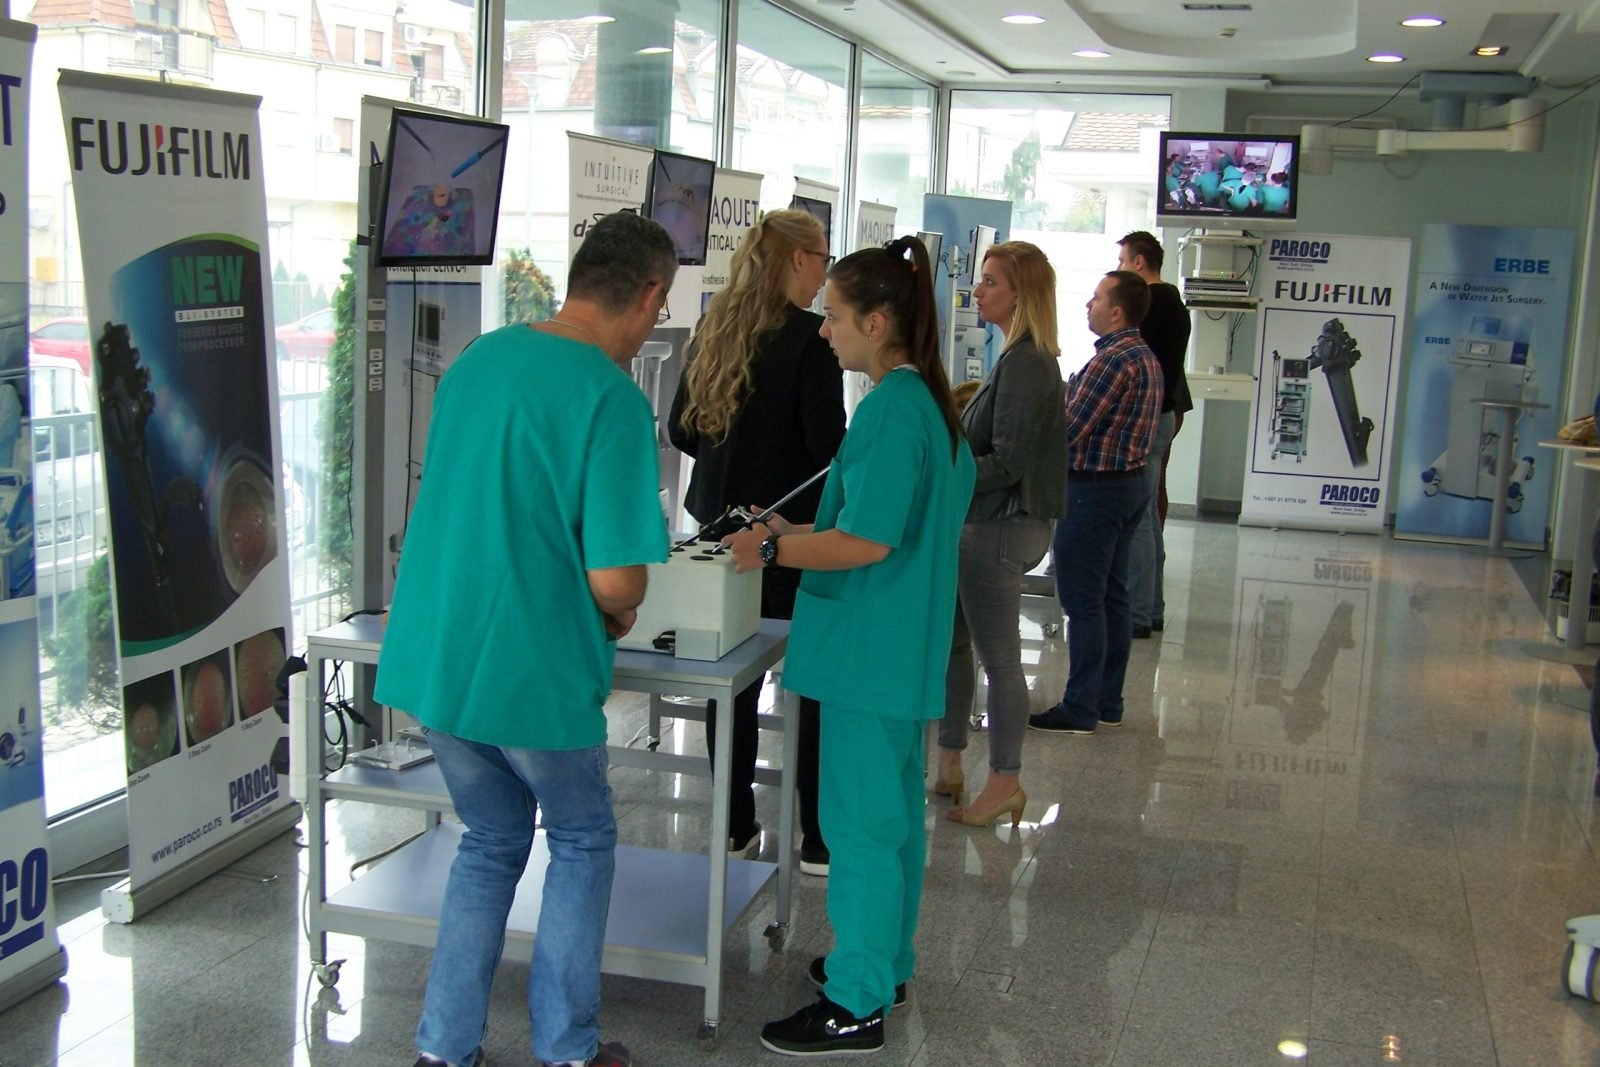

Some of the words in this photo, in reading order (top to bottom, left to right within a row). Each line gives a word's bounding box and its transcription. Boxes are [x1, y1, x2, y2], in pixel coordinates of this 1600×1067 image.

[72, 117, 250, 180] FUJIFILM
[584, 160, 639, 184] INTUITIVE
[710, 196, 760, 230] AQUET
[708, 234, 735, 251] ITICAL
[1270, 239, 1331, 258] PAROCO
[1494, 258, 1550, 274] ERBE
[172, 256, 244, 304] NEW
[1429, 282, 1437, 290] A
[1275, 280, 1392, 306] FUJIFILM
[1425, 336, 1450, 344] ERBE
[1320, 484, 1380, 503] PAROCO
[229, 764, 278, 813] PAROCO
[151, 816, 222, 864] www.paroco.co.rs
